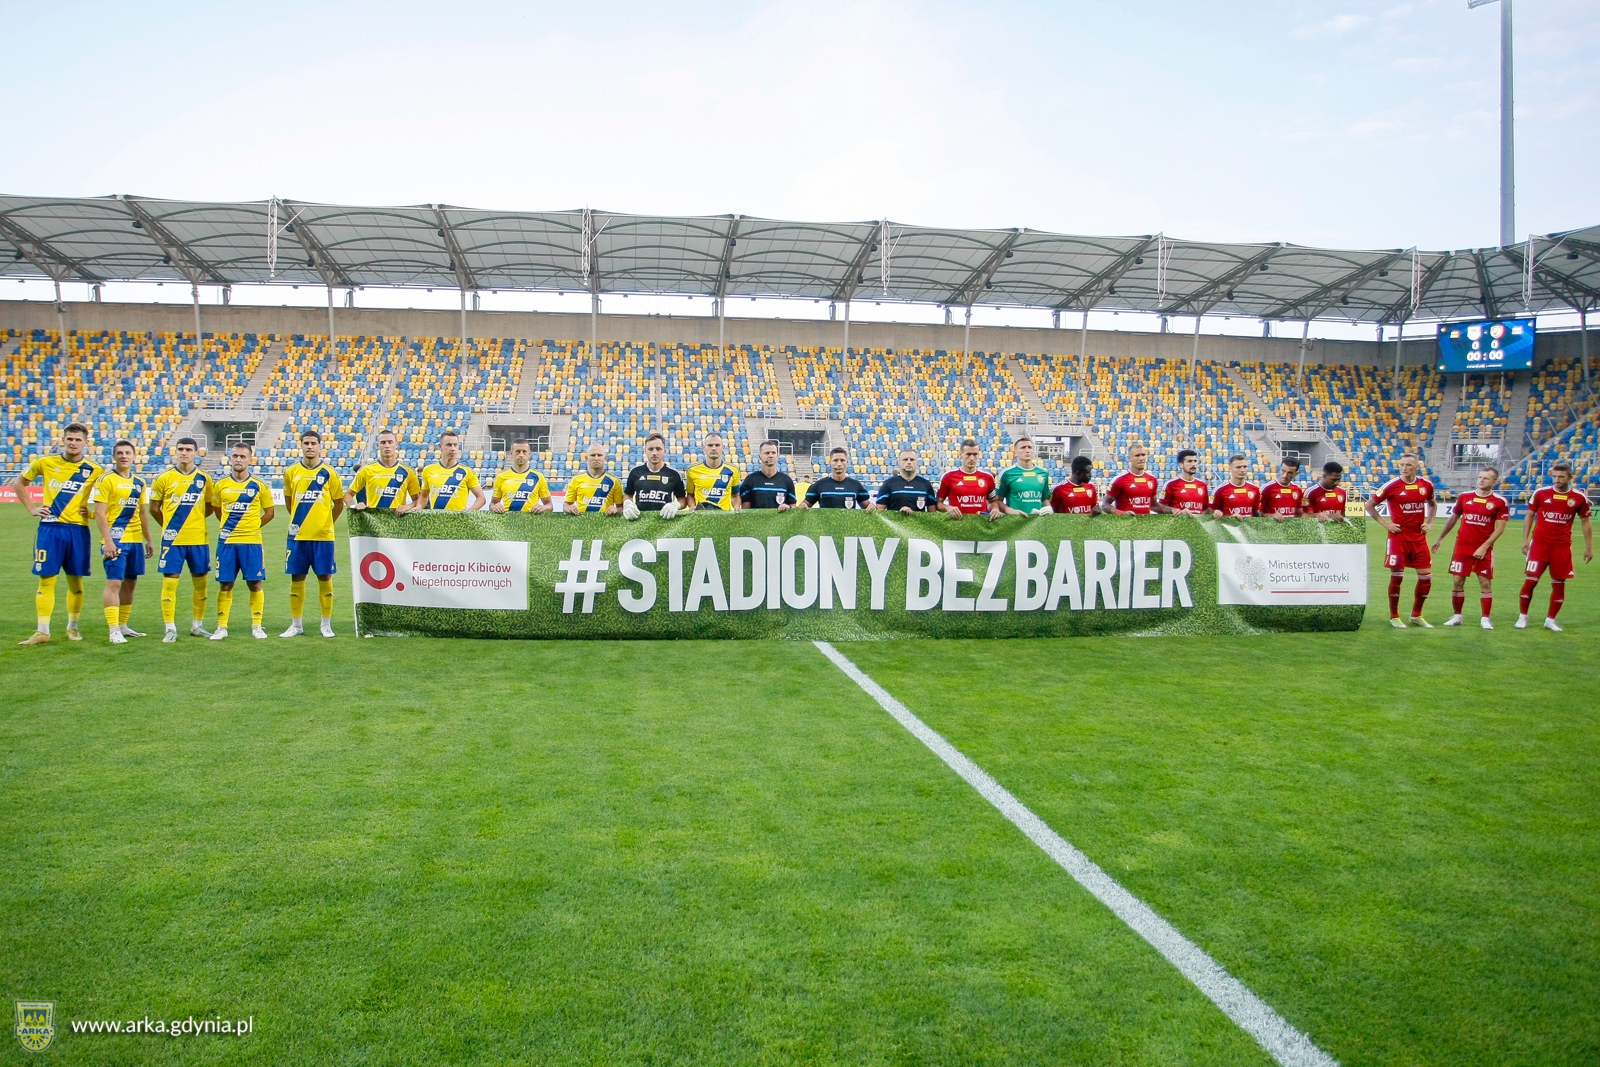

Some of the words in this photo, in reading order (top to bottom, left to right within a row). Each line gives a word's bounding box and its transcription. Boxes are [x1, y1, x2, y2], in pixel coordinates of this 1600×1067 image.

[1472, 341, 1480, 350] 0
[1491, 340, 1499, 349] 0
[48, 478, 86, 491] forBET
[430, 484, 460, 494] forBET
[295, 490, 324, 500] forBET
[375, 486, 400, 495] forBET
[639, 490, 668, 500] forBET
[702, 488, 726, 496] forBET
[170, 492, 204, 502] forBET
[1463, 514, 1490, 522] VOTUM
[1542, 512, 1572, 520] VOTUM
[35, 549, 47, 562] 10
[1389, 555, 1397, 566] 6
[412, 561, 465, 575] Federacja
[468, 562, 512, 573] Kibiców
[1268, 560, 1330, 570] Ministerstwo
[1450, 561, 1462, 572] 20
[1526, 561, 1538, 572] 10
[554, 535, 900, 614] #STADIONY
[906, 538, 1008, 612] BEZ
[1014, 539, 1194, 612] BARIER
[1270, 572, 1300, 584] Sportu
[1303, 573, 1306, 582] i
[1309, 572, 1350, 584] Turystyki
[412, 576, 512, 590] Niepełnosprawnych
